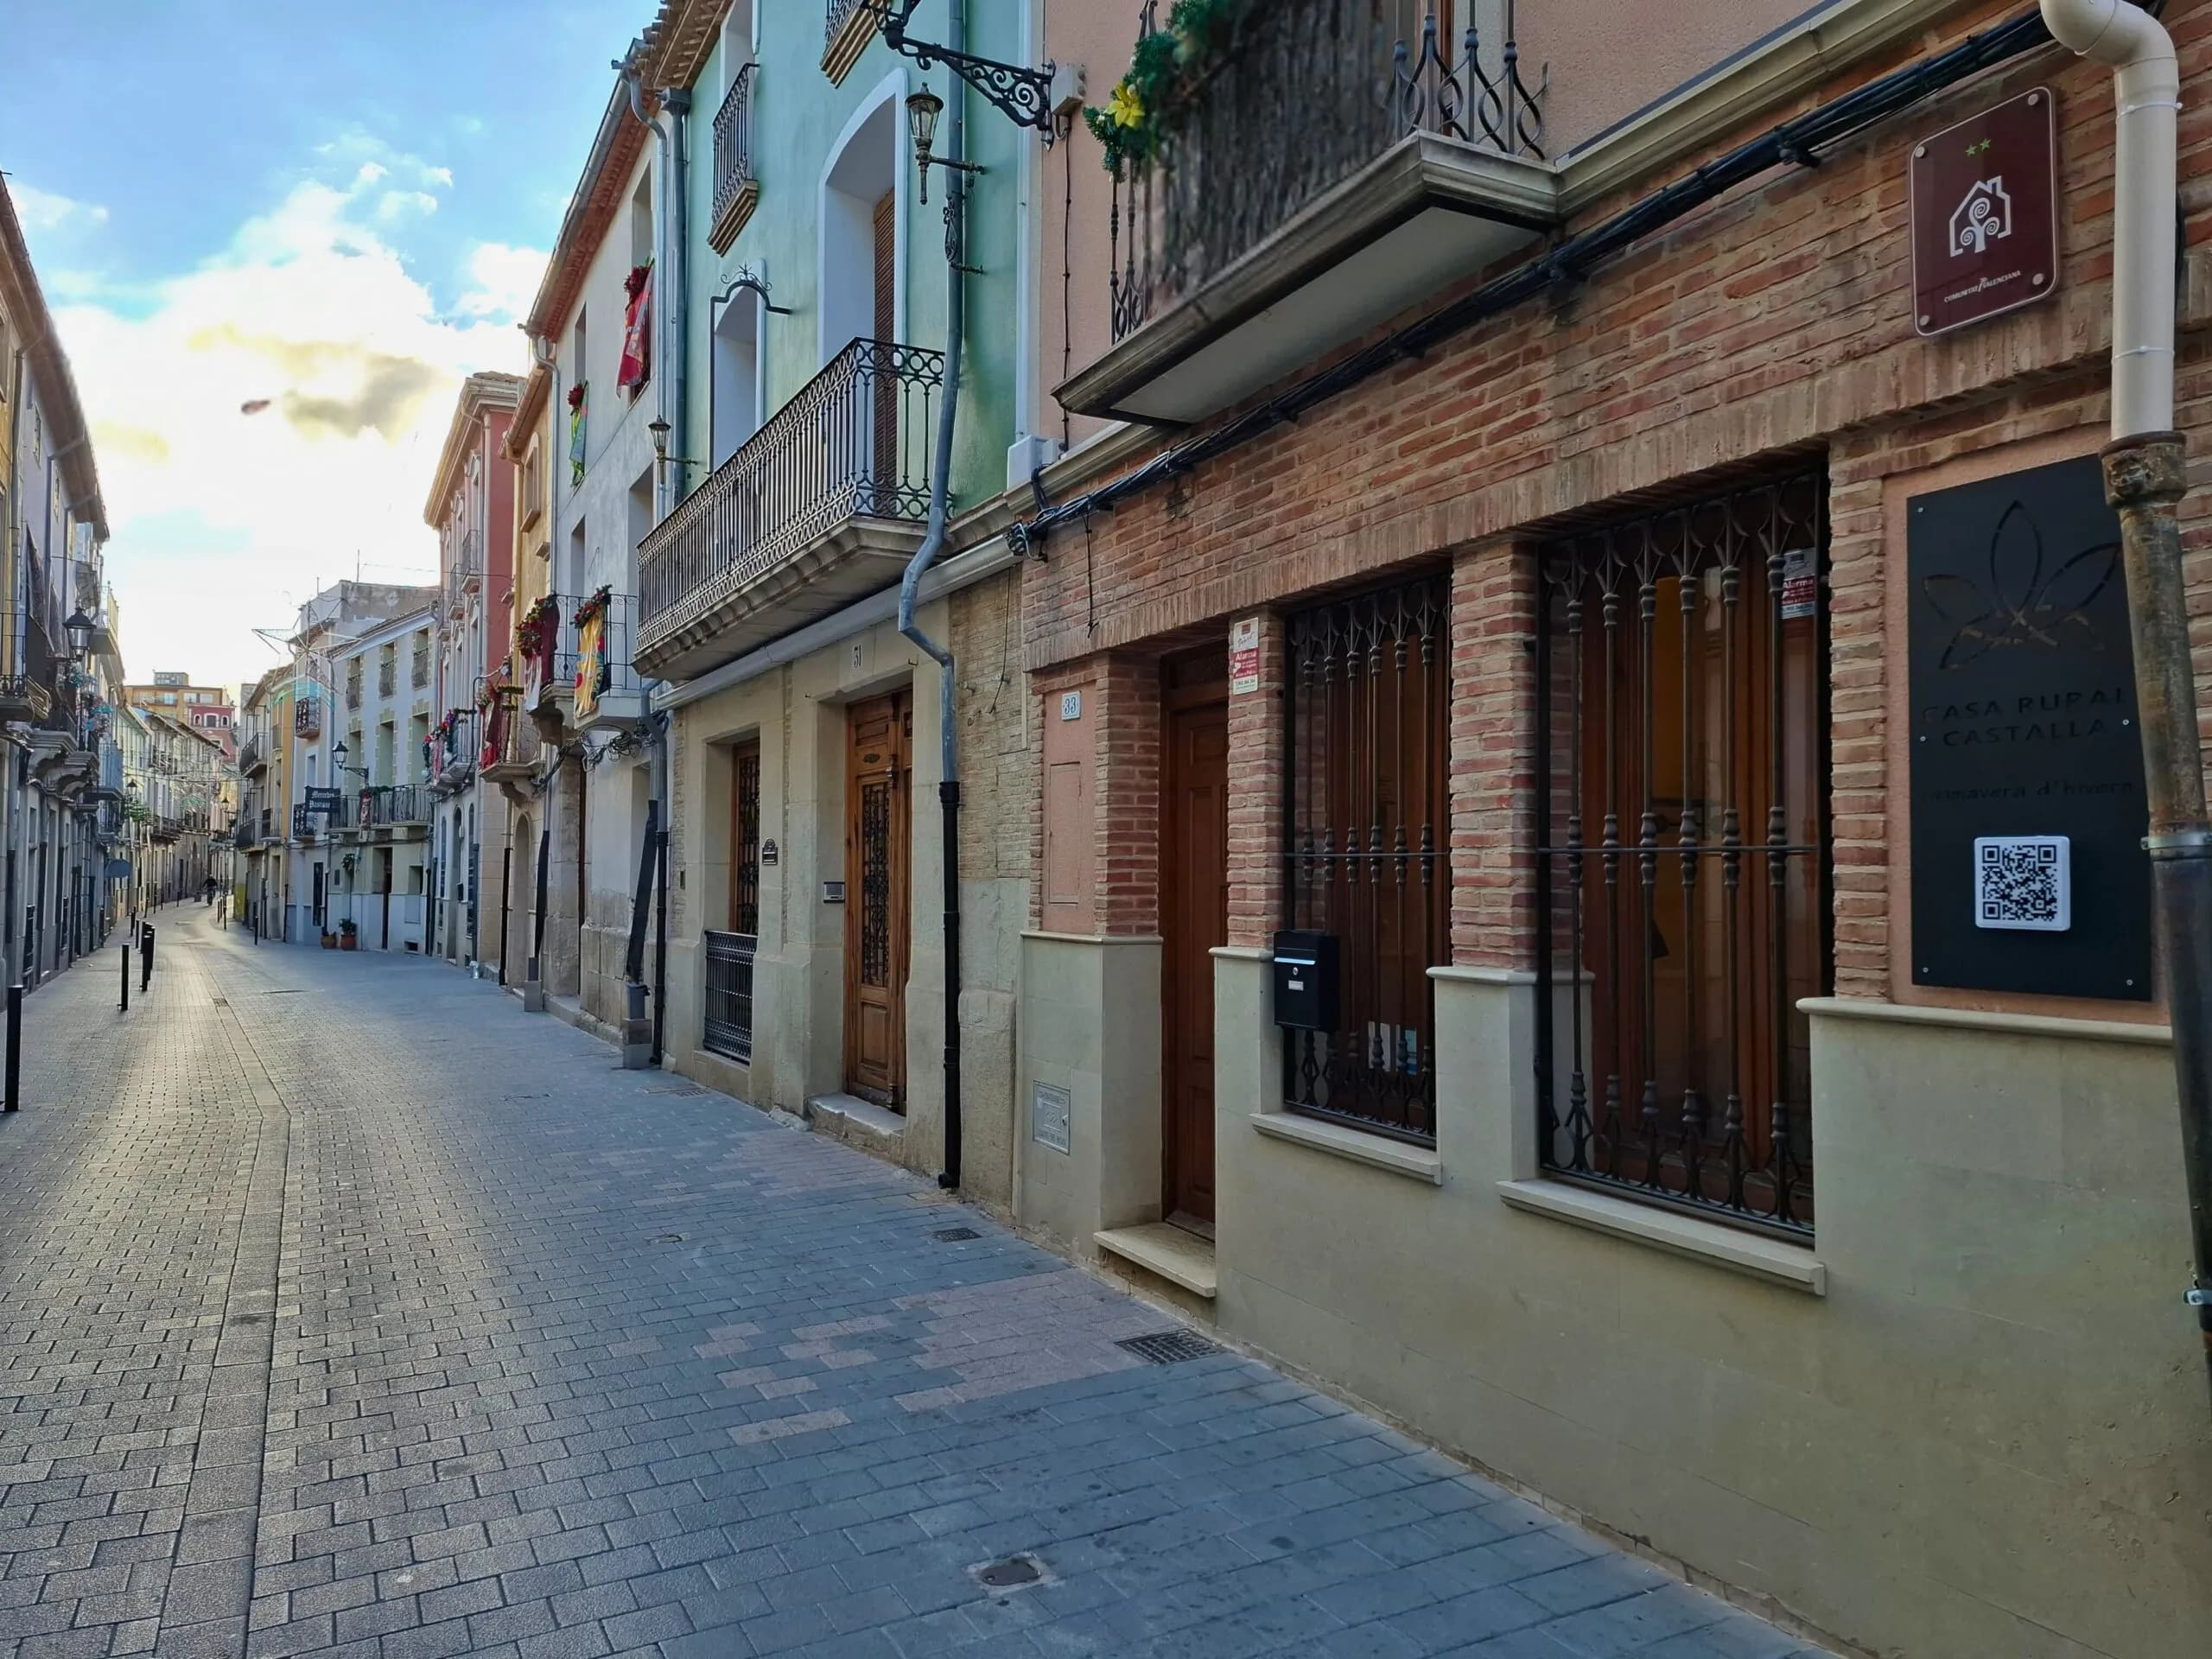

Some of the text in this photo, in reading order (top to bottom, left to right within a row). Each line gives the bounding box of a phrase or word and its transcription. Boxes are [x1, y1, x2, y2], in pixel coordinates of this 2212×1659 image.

[1982, 270, 2021, 289] VALENCIANA
[1783, 578, 1815, 589] Alarma
[1236, 651, 1257, 662] Alarma
[1064, 696, 1077, 715] 33
[1921, 700, 2003, 722] CASA
[1942, 718, 2107, 747] CASTALLA
